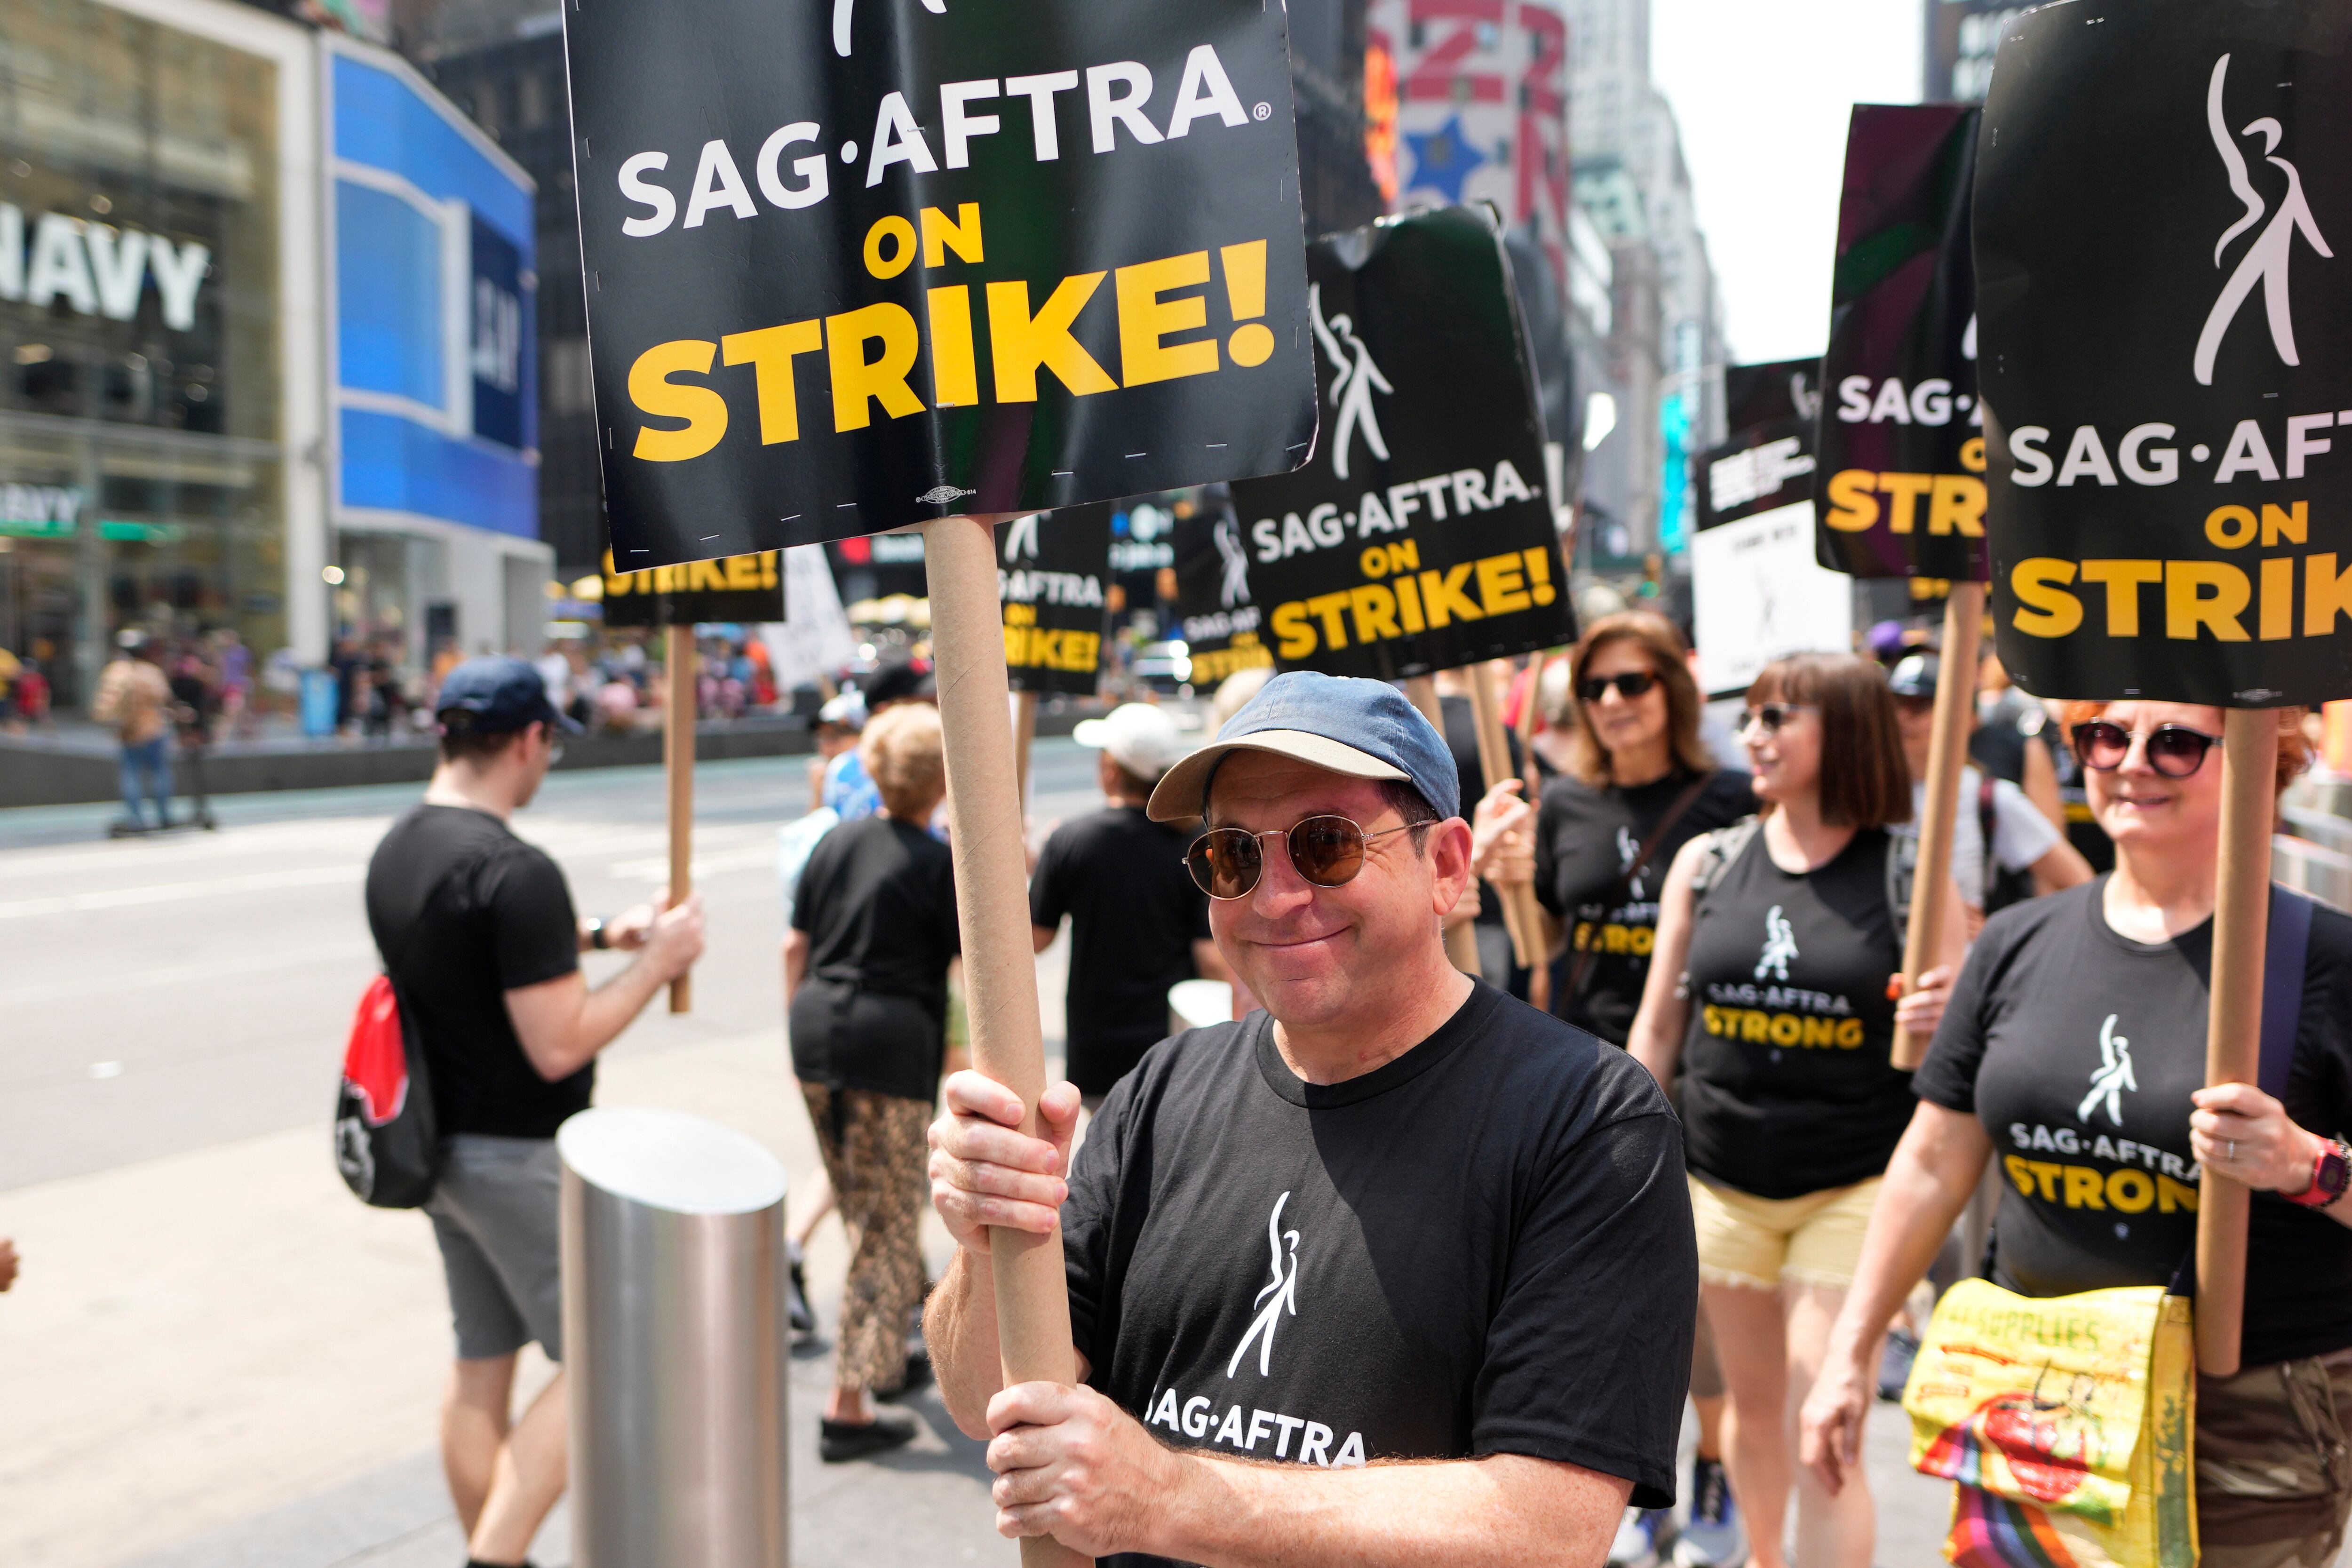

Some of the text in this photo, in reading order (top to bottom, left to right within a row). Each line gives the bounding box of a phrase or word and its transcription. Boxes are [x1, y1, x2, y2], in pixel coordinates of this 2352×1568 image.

[864, 202, 983, 279] ON
[628, 239, 1275, 462] STRIKE!
[1836, 374, 1983, 427] SAG·
[2008, 409, 2352, 487] SAG·AF
[1359, 538, 1421, 580] ON
[2204, 500, 2309, 549] ON
[1270, 546, 1557, 660] STRIKE!
[1703, 1003, 1865, 1051] STRONG
[1144, 1385, 1366, 1470] AG·AFTRA
